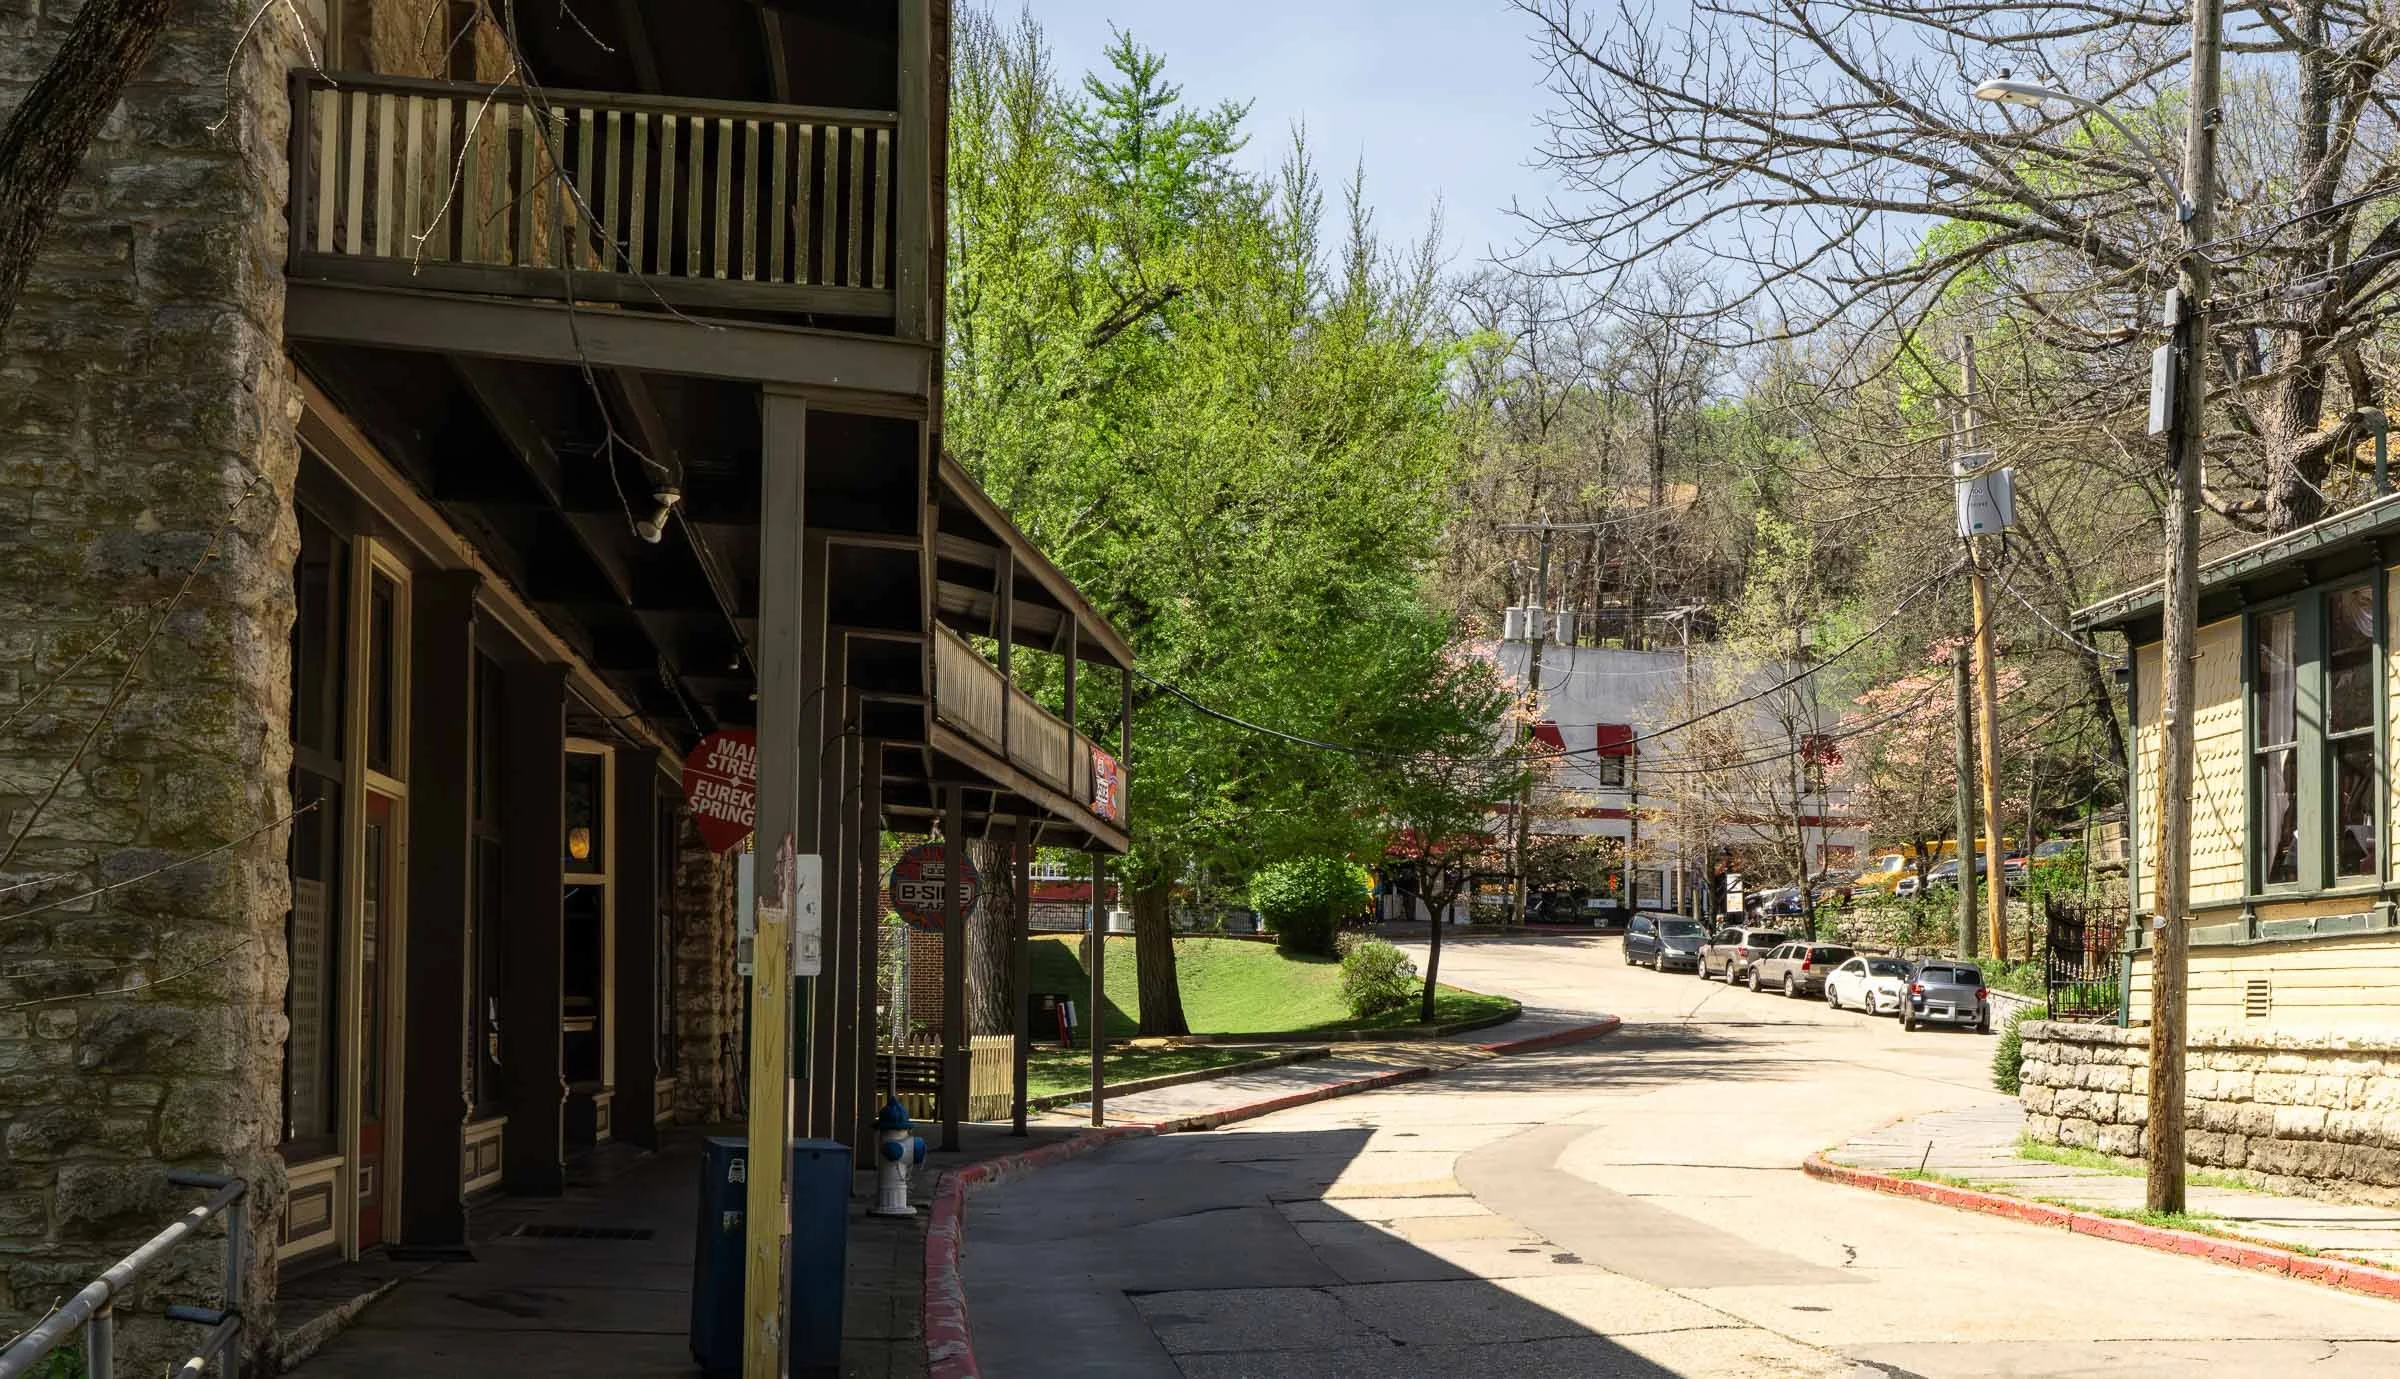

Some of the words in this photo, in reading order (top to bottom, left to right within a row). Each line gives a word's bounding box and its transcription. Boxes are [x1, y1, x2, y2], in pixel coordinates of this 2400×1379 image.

[717, 737, 757, 762] MAI
[695, 779, 757, 809] EUREK
[689, 795, 757, 827] SPRING
[902, 885, 969, 901] B-SIE
